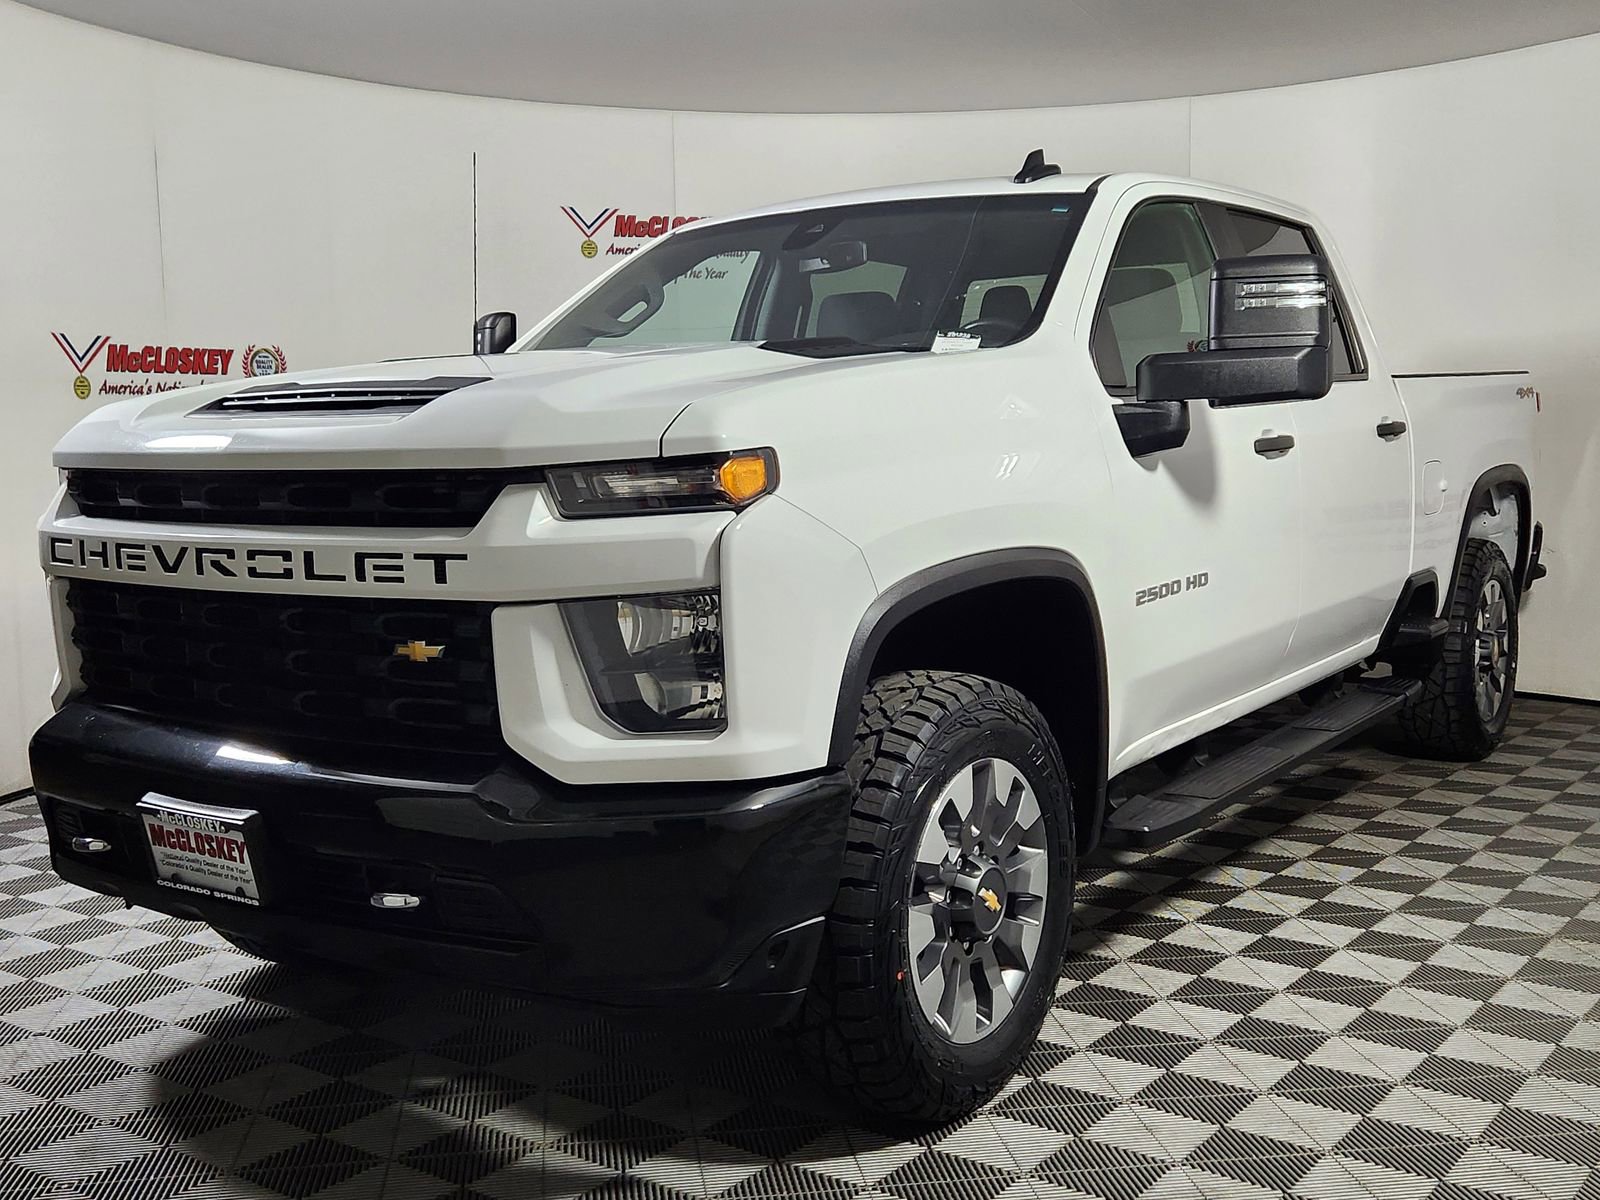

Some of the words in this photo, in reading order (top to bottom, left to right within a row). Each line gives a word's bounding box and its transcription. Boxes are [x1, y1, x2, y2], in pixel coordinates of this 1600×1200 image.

[705, 267, 729, 280] Year
[106, 344, 234, 375] McCLOSKEY
[99, 378, 153, 395] America's
[50, 536, 469, 585] CHEVROLET
[1135, 579, 1182, 607] 2500
[1185, 572, 1209, 592] HD
[159, 810, 221, 833] McCLOSKEY
[148, 823, 246, 864] McCLOSKEY
[157, 879, 211, 895] COLORADO
[213, 891, 260, 906] SPRINGS
